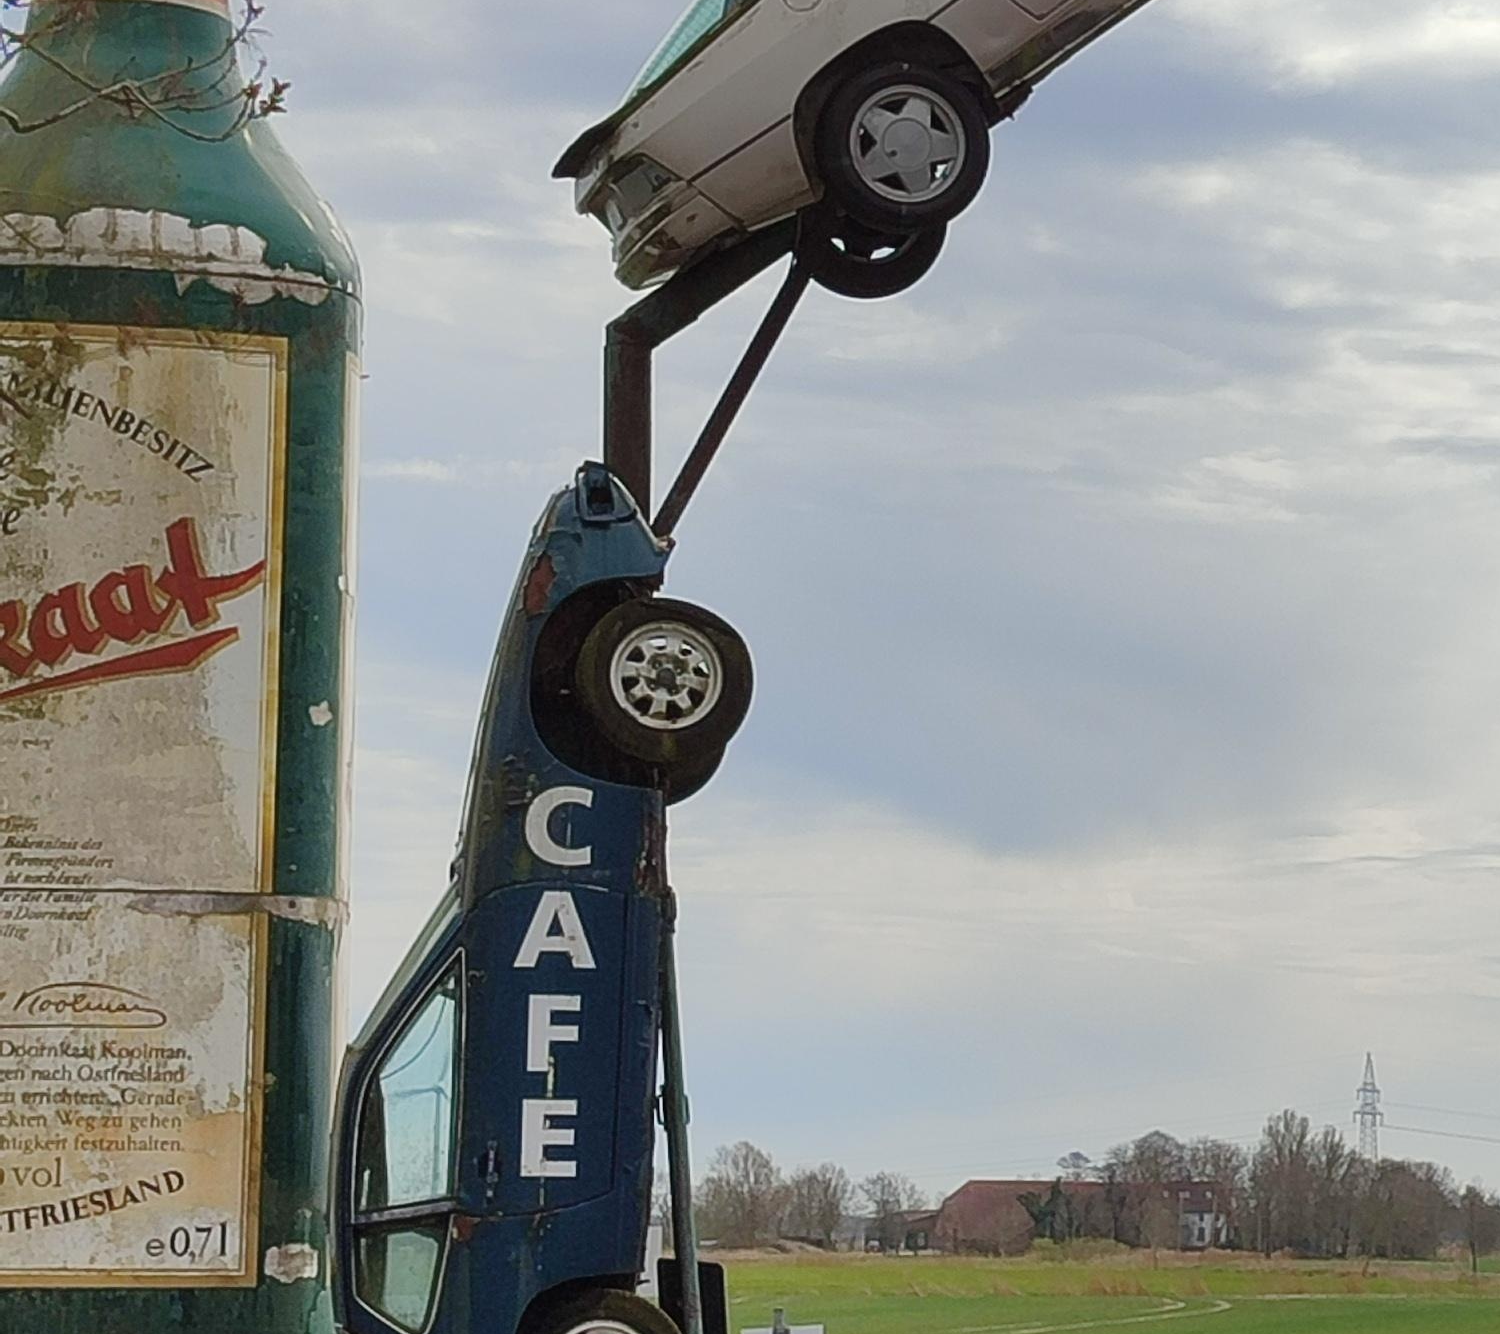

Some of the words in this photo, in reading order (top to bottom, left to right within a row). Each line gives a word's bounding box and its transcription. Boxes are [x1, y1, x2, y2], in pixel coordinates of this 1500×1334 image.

[513, 785, 597, 1178] CAFE
[32, 1064, 72, 1082] nach
[55, 1109, 96, 1132] Weg
[102, 1115, 122, 1128] zu
[130, 1112, 182, 1132] gehen
[12, 1157, 62, 1188] vol
[0, 1170, 184, 1234] TFRIESLAND
